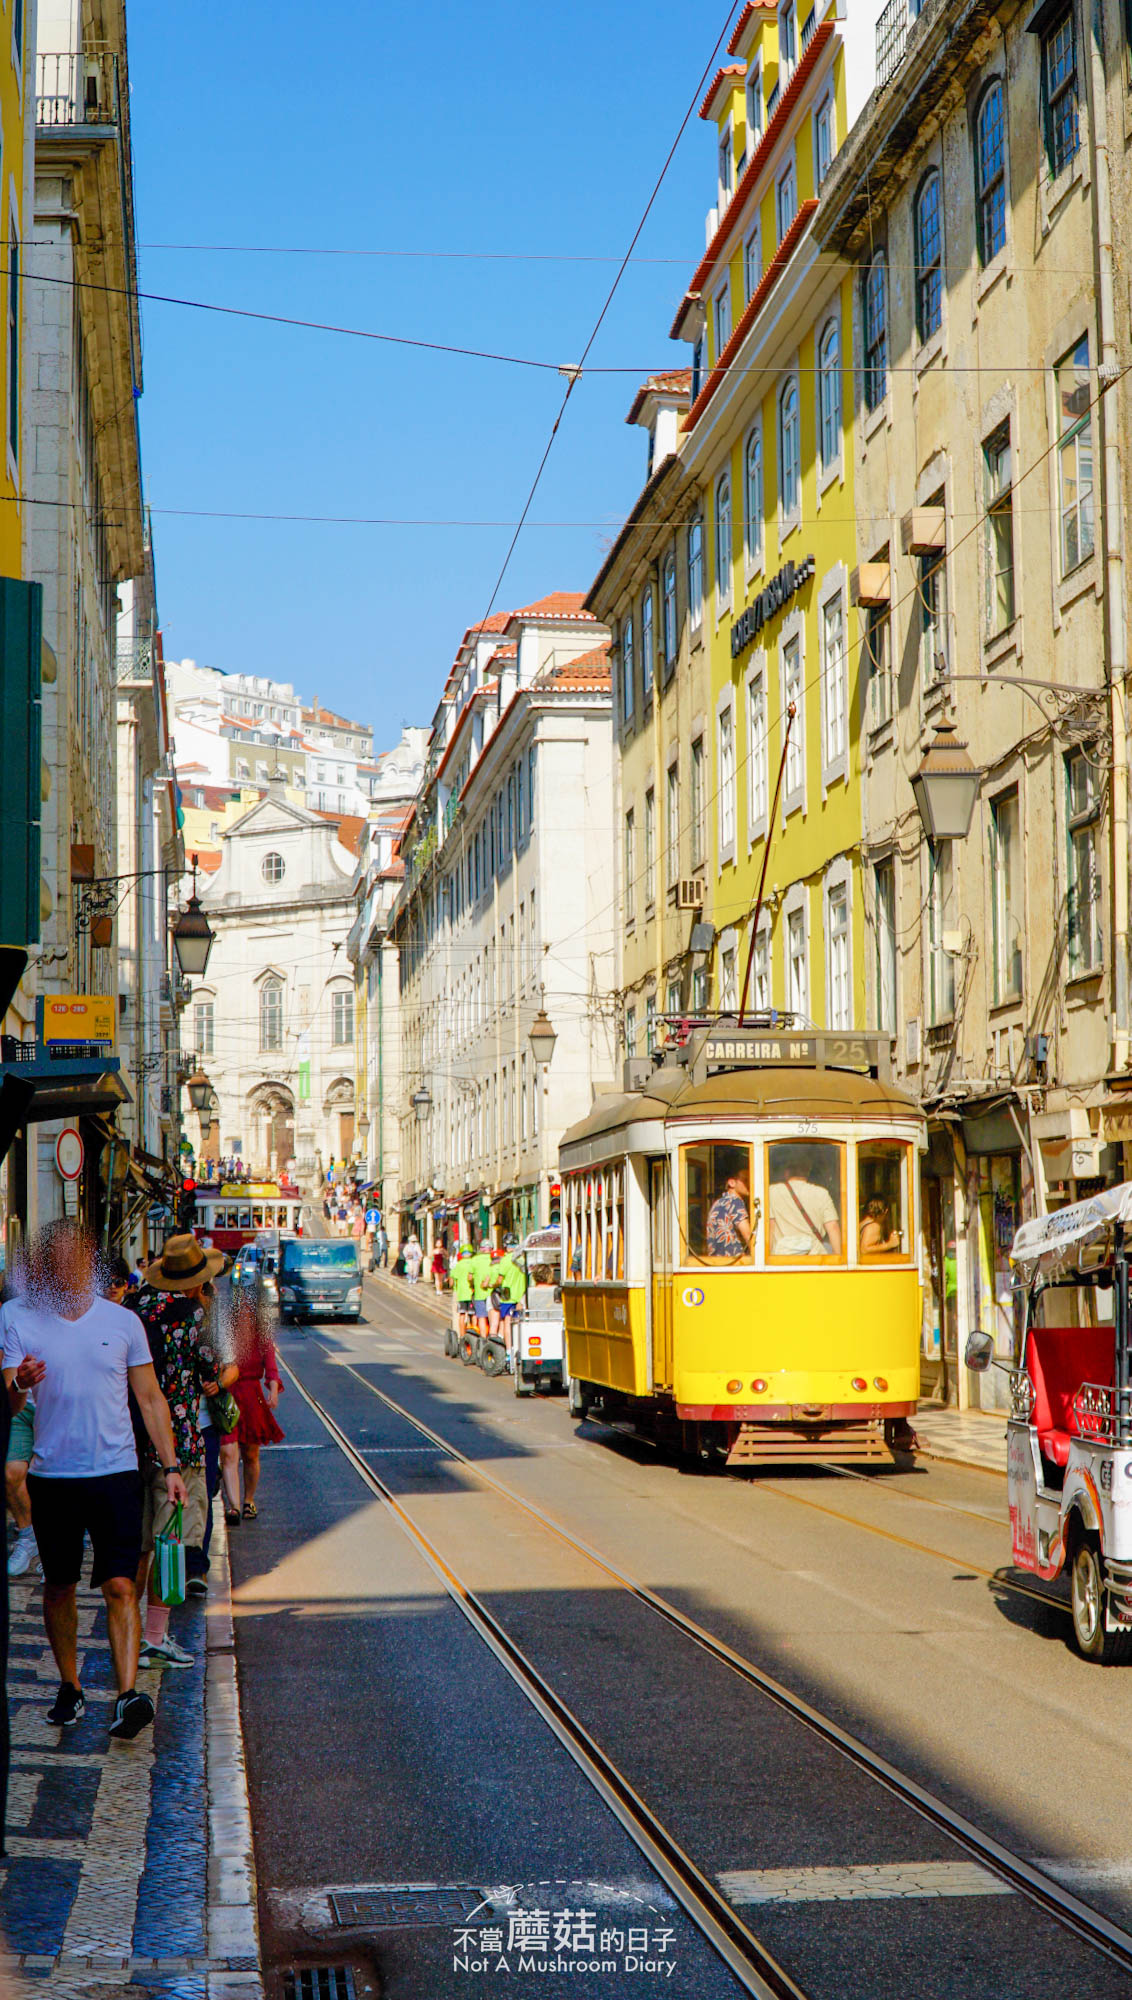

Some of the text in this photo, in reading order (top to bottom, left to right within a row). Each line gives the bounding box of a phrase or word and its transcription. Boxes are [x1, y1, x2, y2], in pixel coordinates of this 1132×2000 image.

[705, 1042, 781, 1059] CARREIRA
[832, 1041, 865, 1061] 25
[797, 1123, 818, 1134] 575
